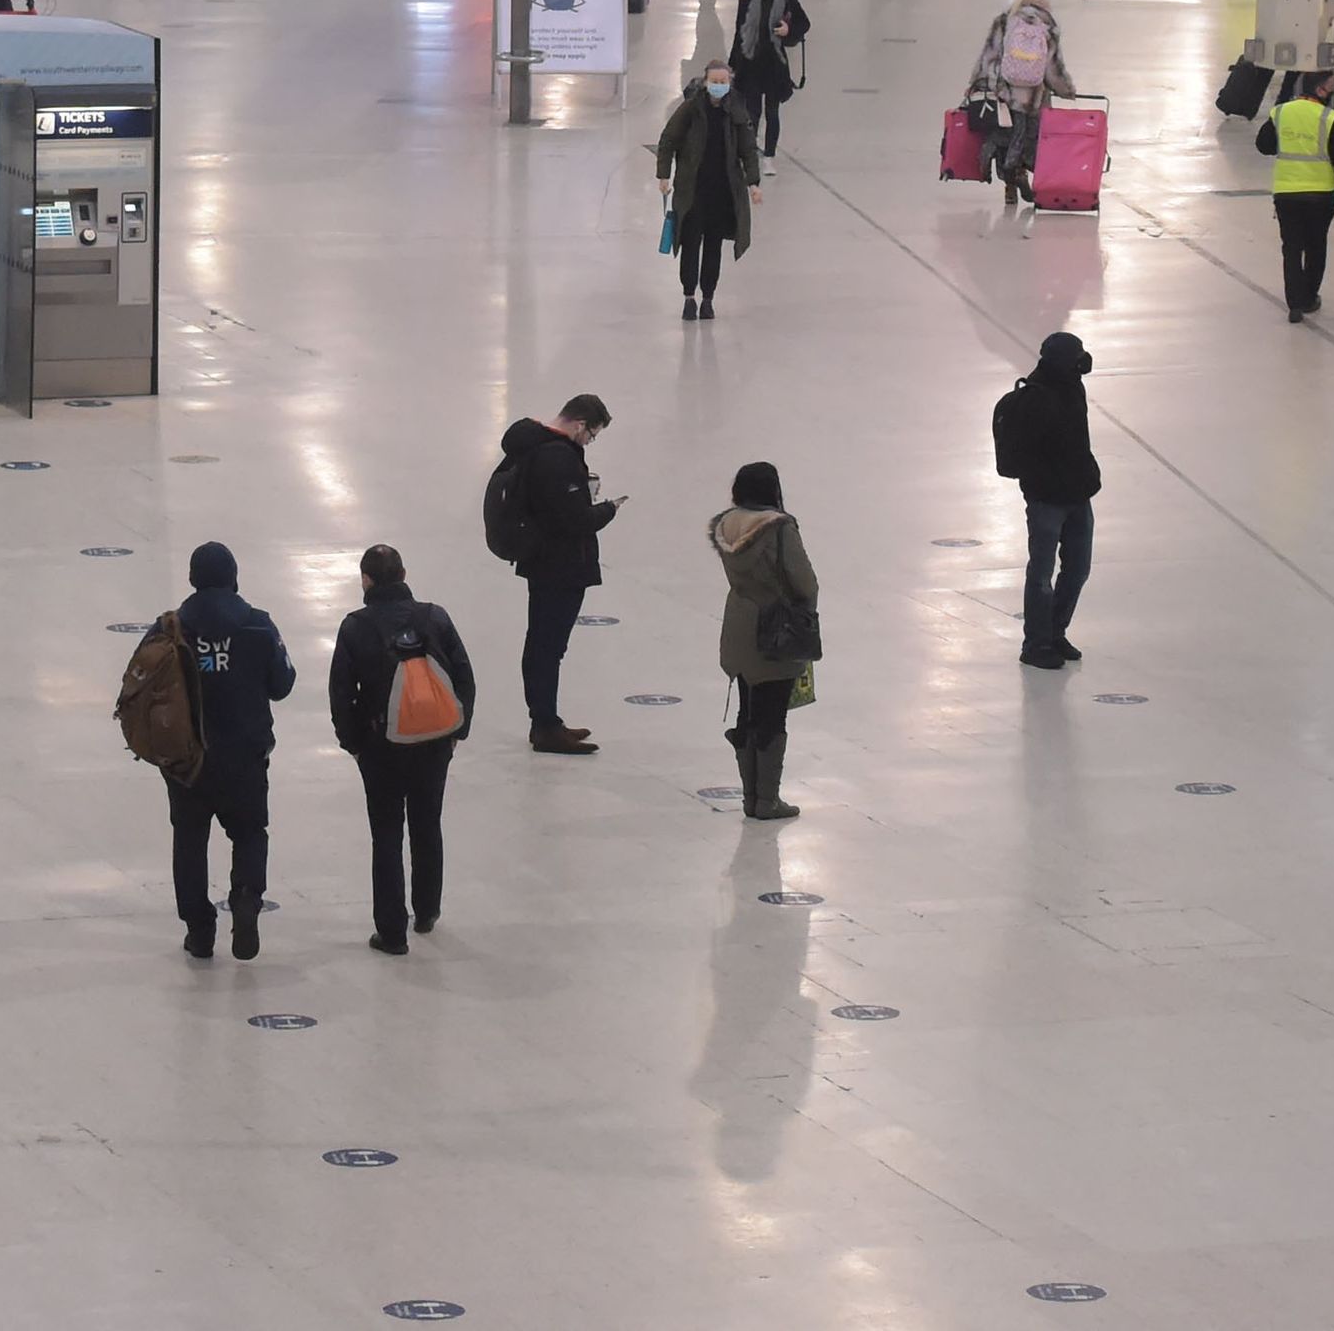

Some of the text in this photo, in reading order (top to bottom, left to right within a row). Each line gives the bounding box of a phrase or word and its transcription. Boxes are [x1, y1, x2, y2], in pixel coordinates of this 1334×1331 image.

[59, 111, 106, 123] TICKETS
[58, 125, 114, 136] Card Payments
[197, 636, 231, 653] SW
[216, 653, 229, 671] R
